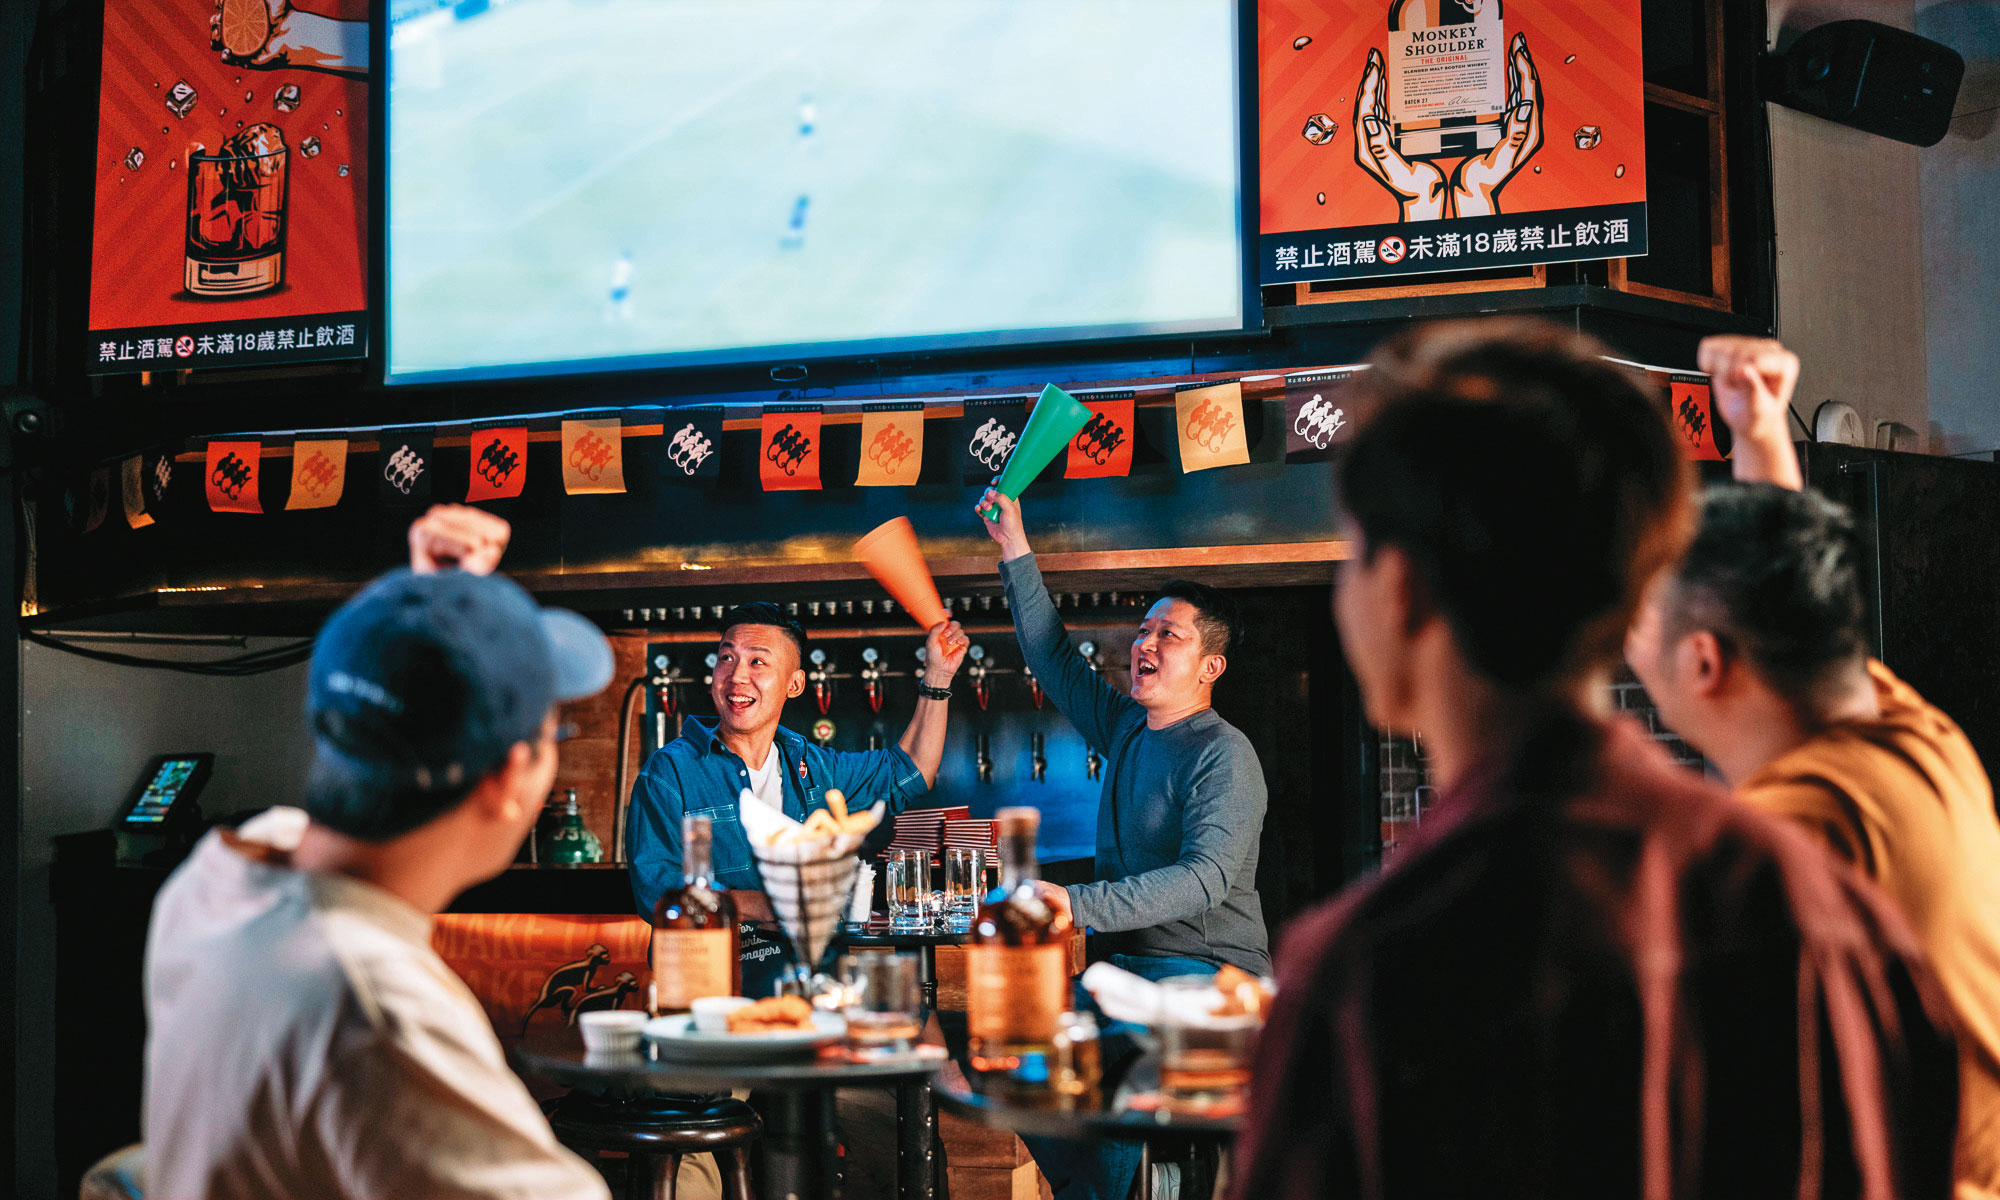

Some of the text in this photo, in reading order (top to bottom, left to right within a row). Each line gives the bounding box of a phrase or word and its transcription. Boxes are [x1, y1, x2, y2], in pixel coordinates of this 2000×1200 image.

[1412, 26, 1477, 43] MONKEY
[1405, 39, 1485, 56] SHOULDER
[1421, 55, 1467, 65] THE ORIGINAL
[1275, 218, 1630, 271] 禁止酒駕 未滿18歲禁止飲酒
[99, 324, 355, 362] 禁止酒駕 未滿18歲禁止飲酒
[739, 922, 754, 934] or
